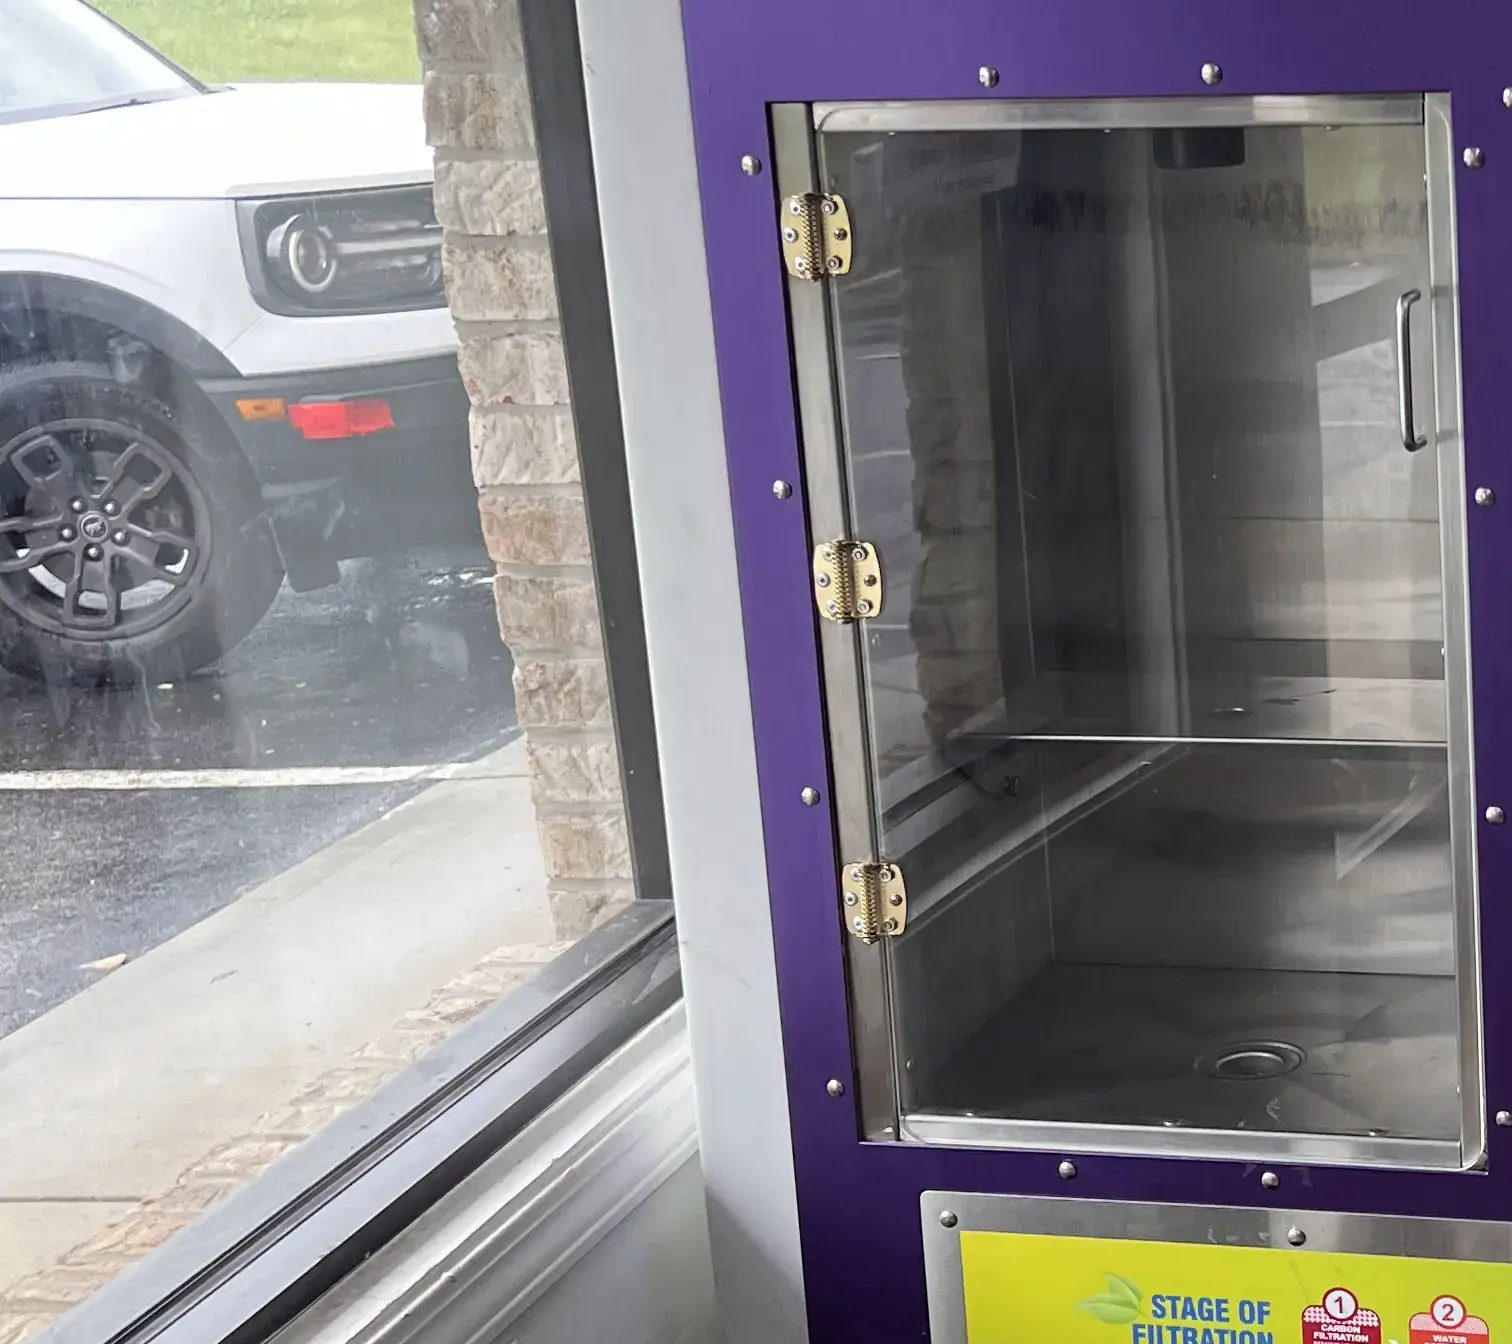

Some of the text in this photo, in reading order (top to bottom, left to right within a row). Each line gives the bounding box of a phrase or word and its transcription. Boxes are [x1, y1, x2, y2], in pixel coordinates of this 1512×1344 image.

[1151, 1294, 1270, 1325] STAGE OF
[1334, 1296, 1344, 1314] 1
[1442, 1304, 1454, 1322] 2
[1321, 1323, 1361, 1334] CARBON
[1313, 1331, 1369, 1343] FILTRATION
[1432, 1334, 1467, 1344] WATER
